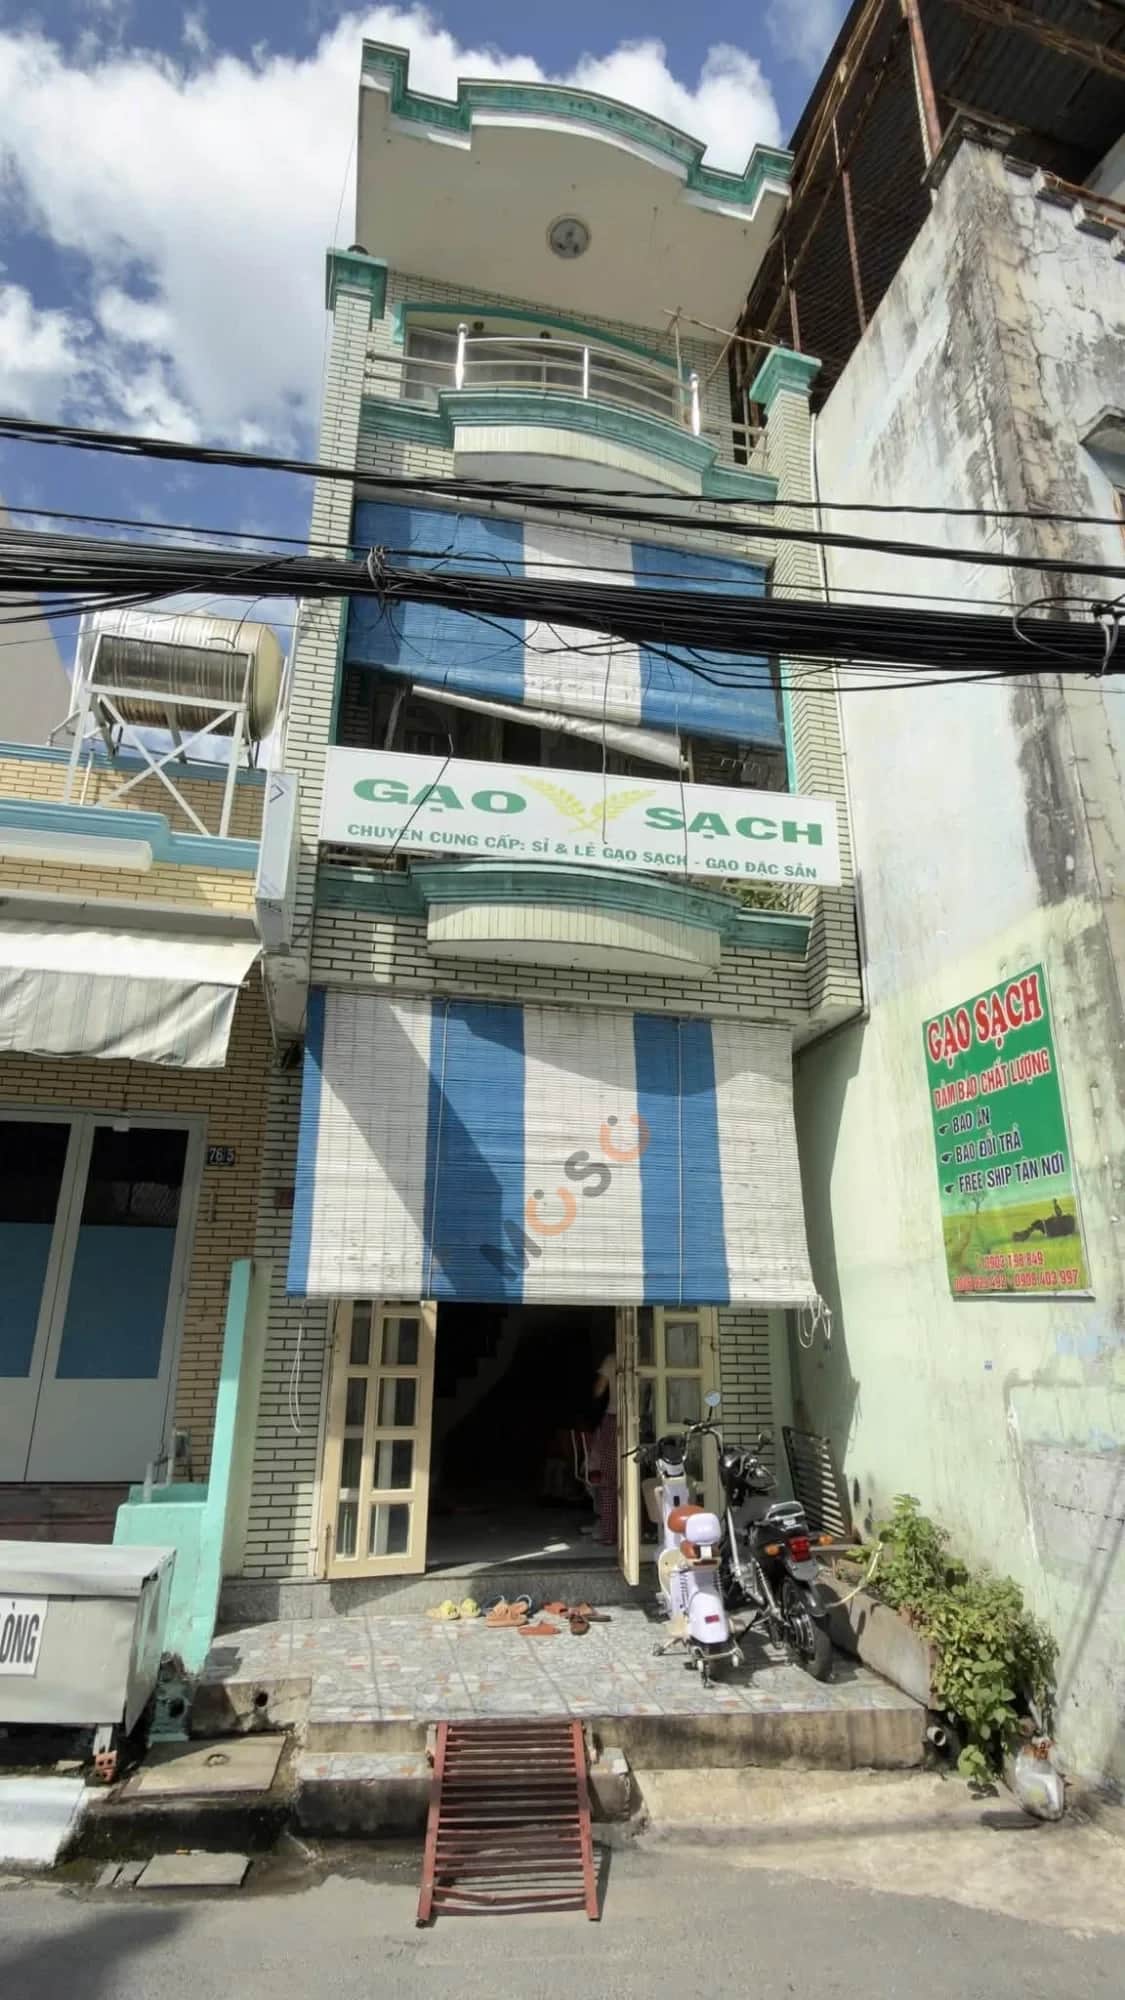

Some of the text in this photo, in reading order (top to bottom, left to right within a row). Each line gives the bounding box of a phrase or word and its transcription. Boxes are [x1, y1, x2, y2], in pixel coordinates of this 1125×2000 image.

[353, 778, 823, 846] GẠO SẠCH
[430, 830, 479, 847] CUNG
[555, 843, 568, 855] &
[602, 846, 637, 863] GẠO
[643, 850, 688, 867] SẠCH
[705, 856, 739, 873] GẠO
[928, 972, 1044, 1069] GẠO SẠCH
[952, 1112, 974, 1134] BAO
[955, 1141, 977, 1164] BAO
[958, 1170, 984, 1194] FREE
[986, 1165, 1012, 1189] SHIP
[1041, 1150, 1066, 1178] NƠI
[0, 1601, 40, 1664] ÒNG
